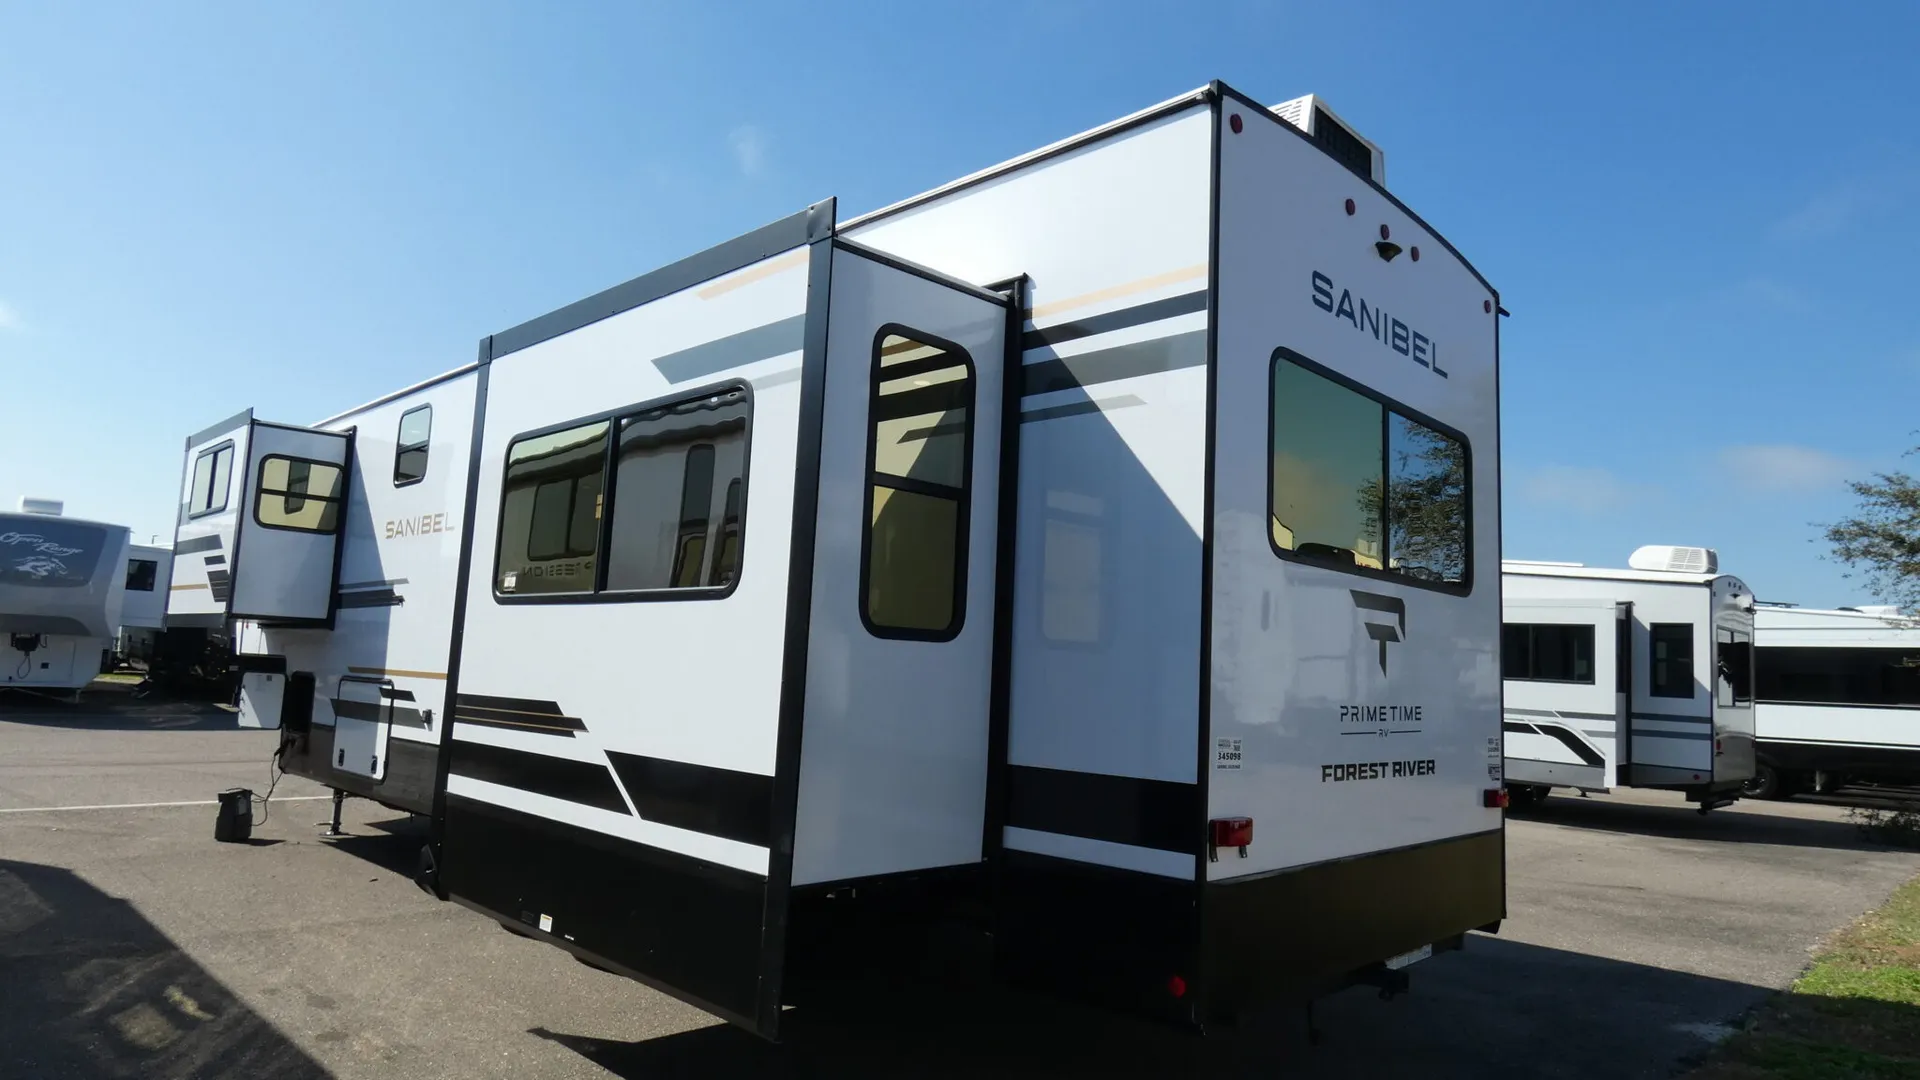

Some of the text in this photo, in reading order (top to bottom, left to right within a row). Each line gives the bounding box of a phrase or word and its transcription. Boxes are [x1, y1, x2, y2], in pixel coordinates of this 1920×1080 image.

[1312, 270, 1448, 379] SANIBEL
[385, 512, 455, 540] SANIBEL
[1378, 729, 1389, 737] RV
[1321, 759, 1436, 782] FOREST RIVER
